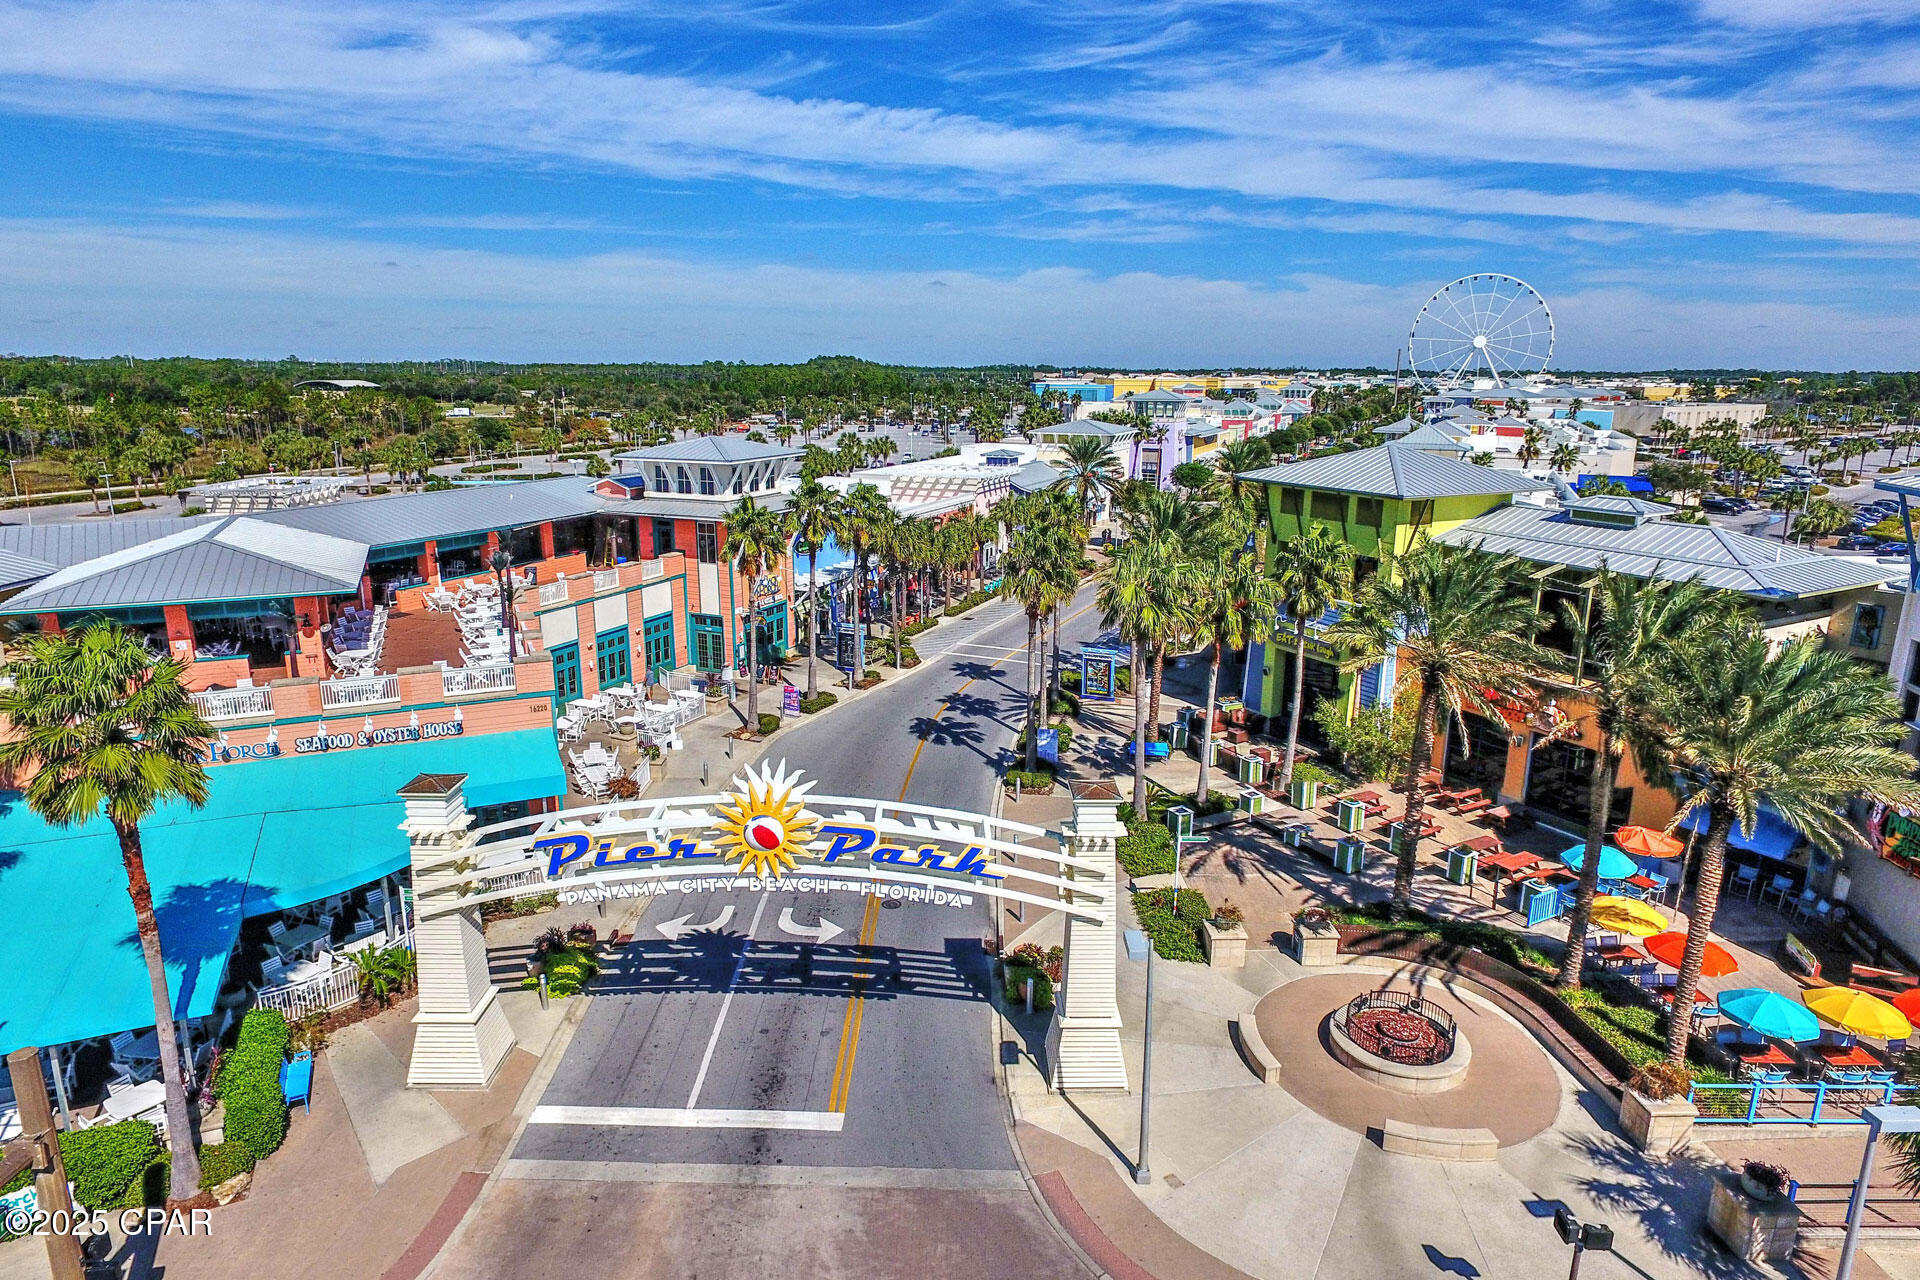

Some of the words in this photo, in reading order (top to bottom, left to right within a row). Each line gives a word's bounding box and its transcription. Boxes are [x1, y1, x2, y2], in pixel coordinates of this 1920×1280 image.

[530, 704, 548, 712] 16220
[208, 741, 287, 763] PORCH
[295, 733, 354, 753] SEAFOOD
[357, 731, 371, 746] &
[372, 725, 421, 743] OYSTER
[422, 720, 464, 738] HOUSE
[531, 830, 721, 876] Pier
[815, 821, 1008, 880] Park
[564, 879, 668, 906] PANAMA
[679, 876, 737, 894] CITY
[748, 876, 830, 894] BEACH
[860, 881, 964, 909] FLORIDA
